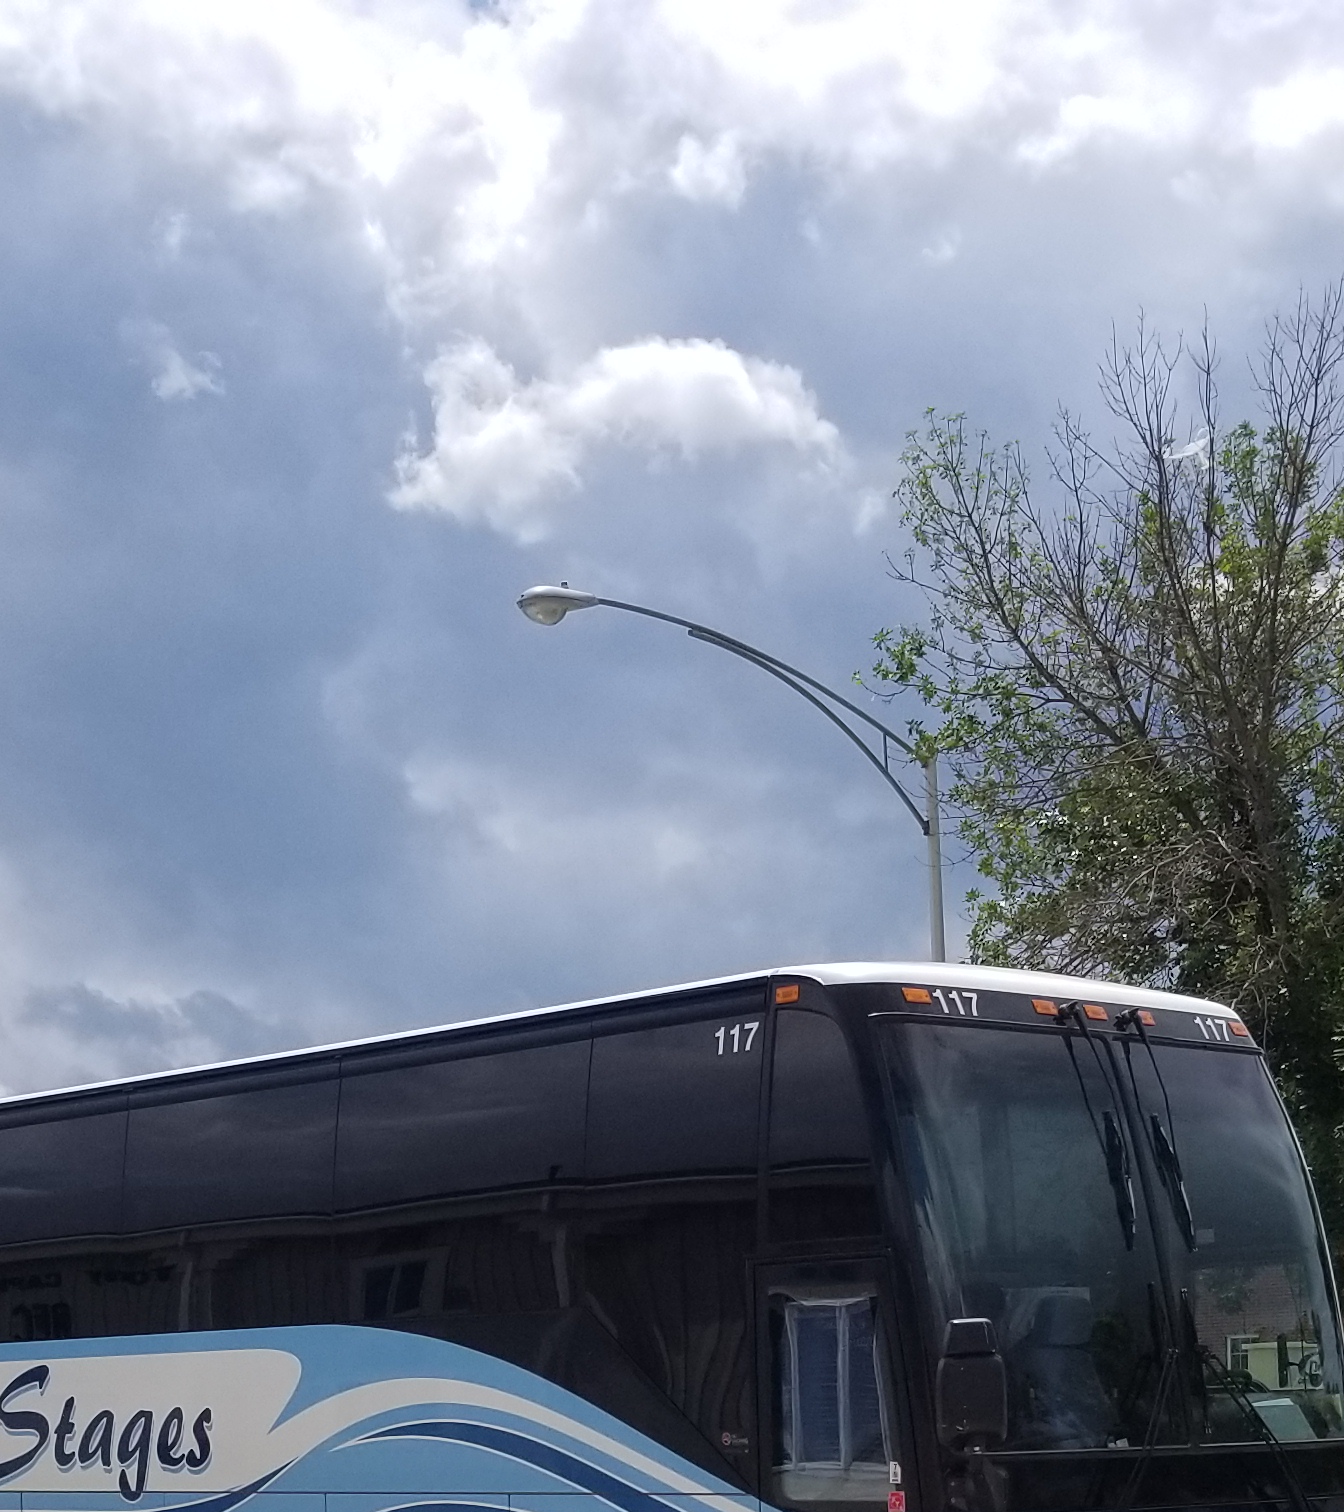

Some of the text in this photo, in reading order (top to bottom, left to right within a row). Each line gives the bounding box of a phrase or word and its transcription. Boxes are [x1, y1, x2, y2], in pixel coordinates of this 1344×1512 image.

[932, 988, 978, 1017] 117
[715, 1021, 759, 1055] 117
[1193, 1016, 1230, 1042] 117
